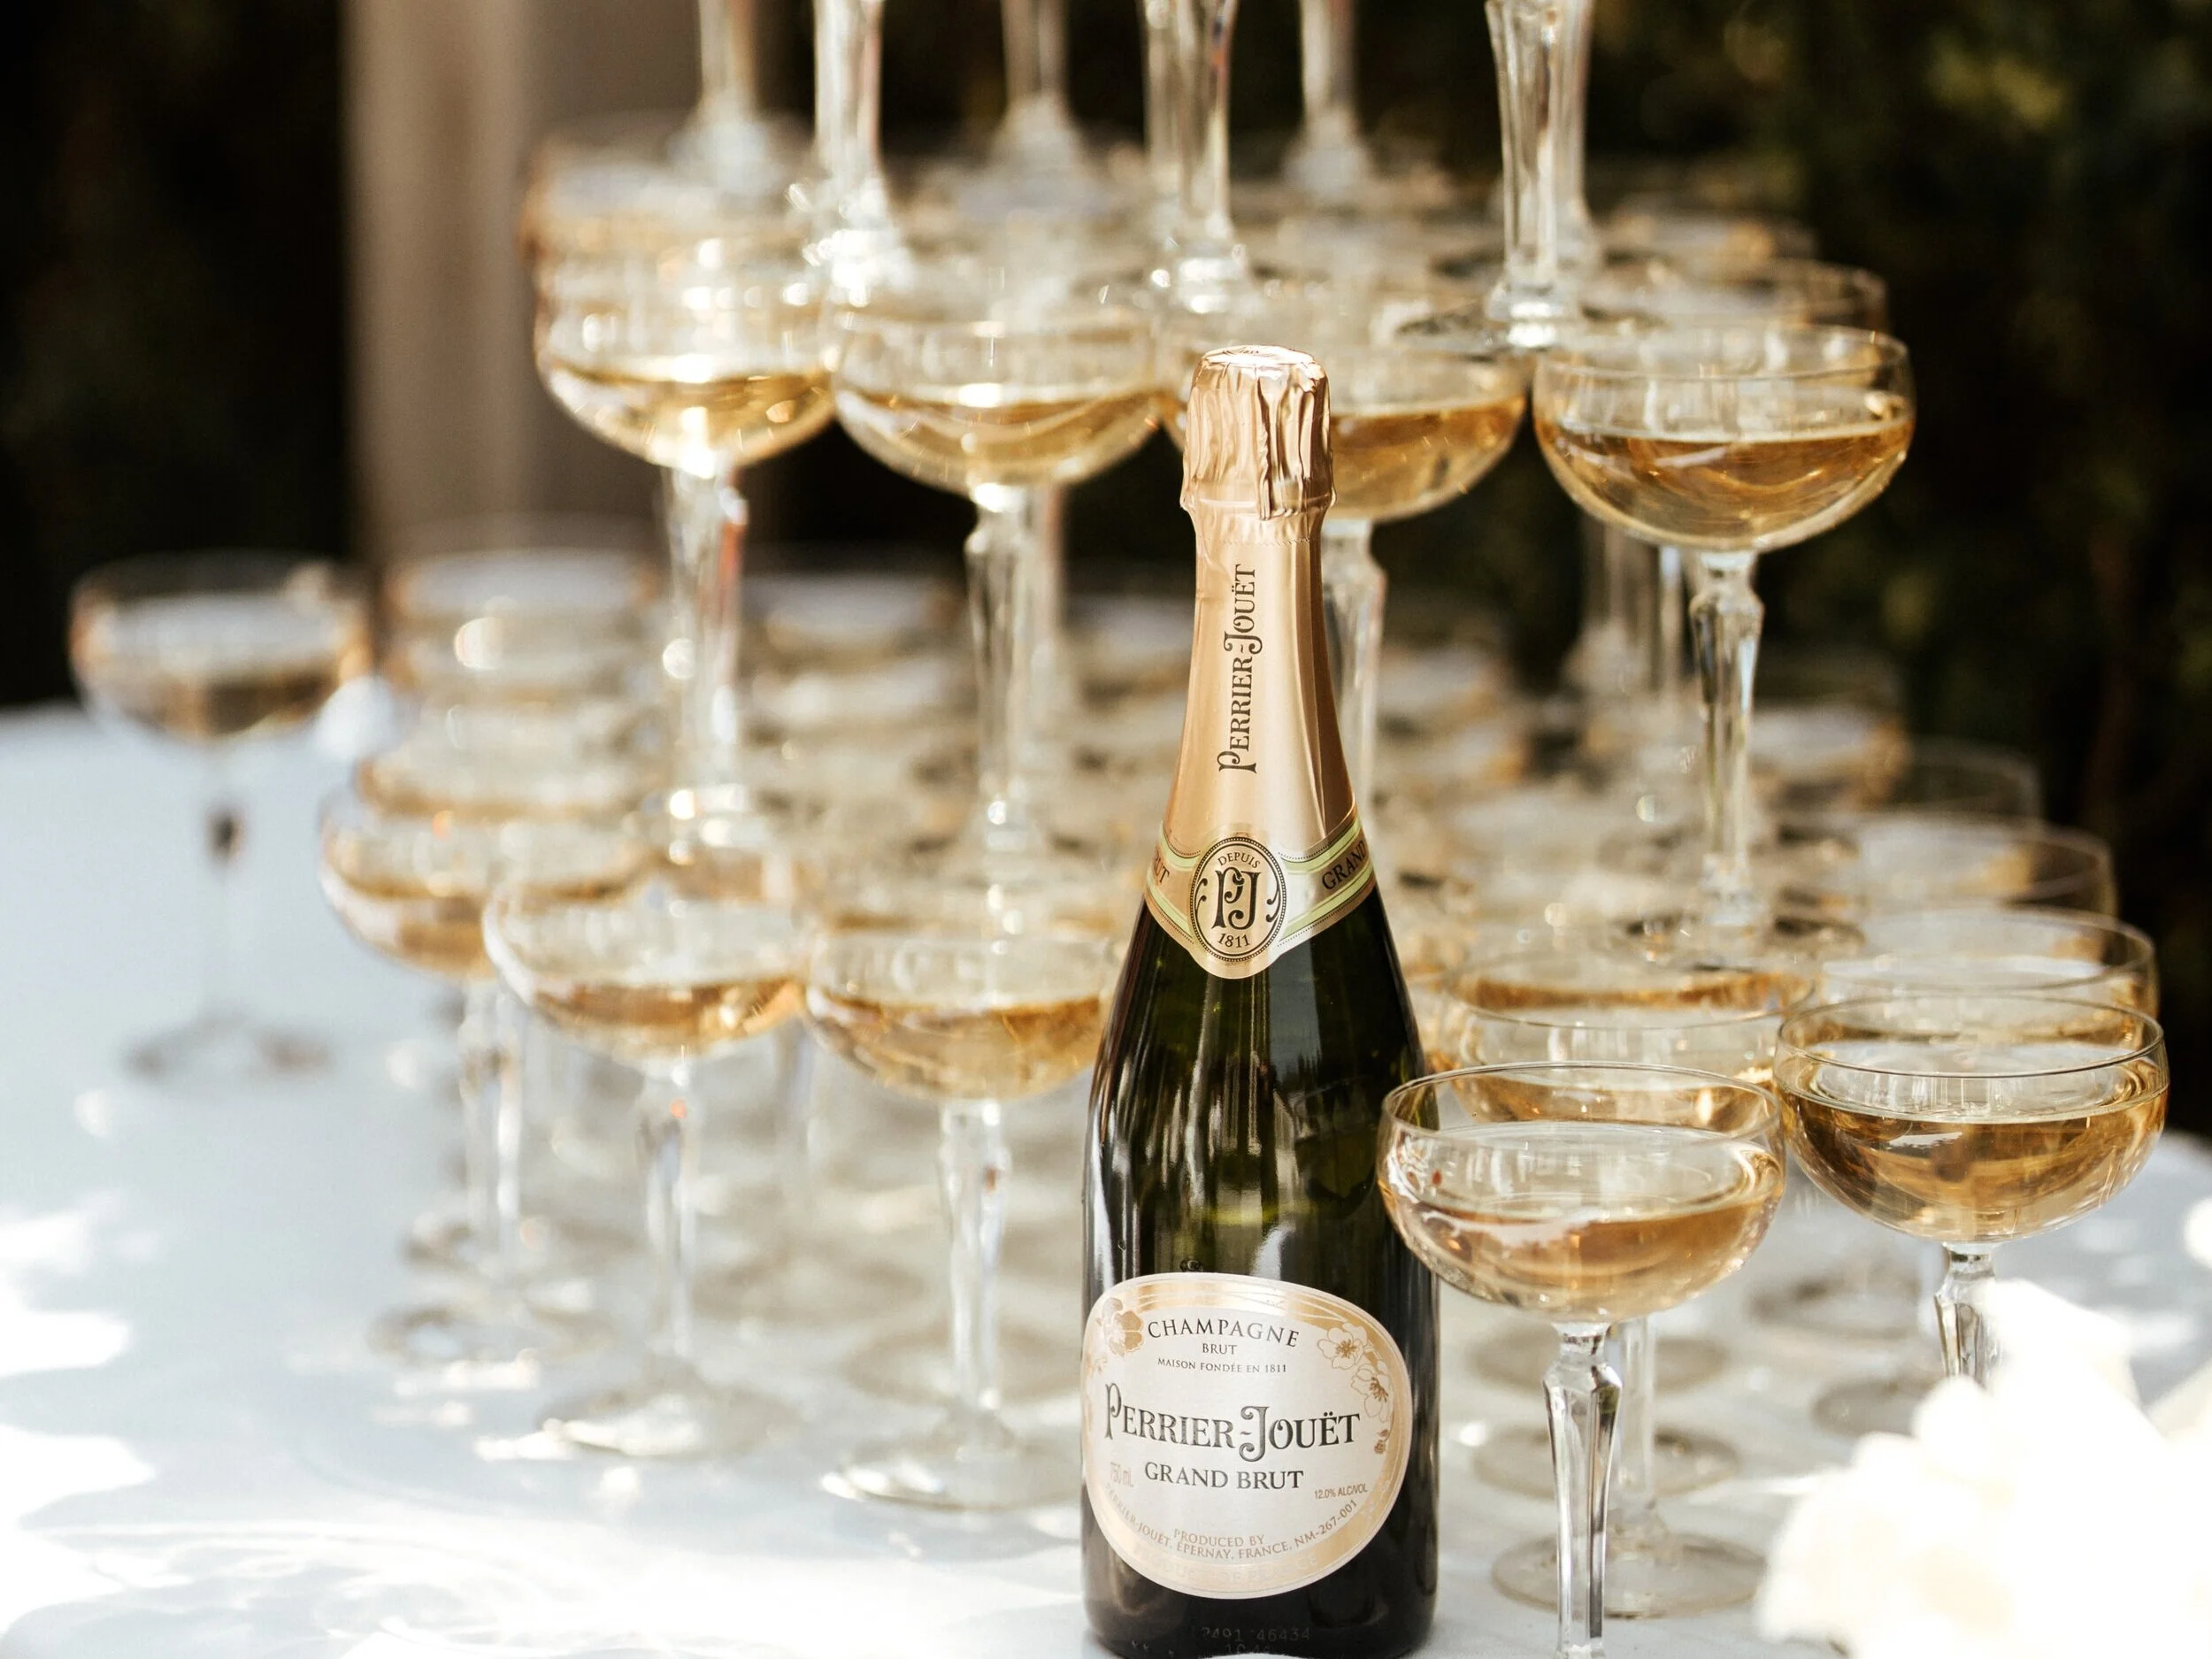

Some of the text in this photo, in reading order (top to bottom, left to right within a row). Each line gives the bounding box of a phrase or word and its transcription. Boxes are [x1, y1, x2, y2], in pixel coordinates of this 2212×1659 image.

[1217, 564, 1263, 773] PERRIER-JOUËT
[1217, 851, 1260, 869] DEPUIS
[1322, 840, 1367, 889] GRAND
[1217, 933, 1250, 949] 1811
[1148, 1317, 1300, 1348] CHAMPAGNE
[1202, 1342, 1238, 1356] BRUT
[1157, 1357, 1286, 1373] MAISON FONDÉE EN 1811
[1105, 1382, 1361, 1463] PERRIER-JOUËT
[1145, 1461, 1304, 1490] GRAND BRUT
[1314, 1488, 1336, 1500] 12.0%
[1294, 1499, 1357, 1548] NM-267-001
[1174, 1528, 1264, 1548] PRODUCED BY
